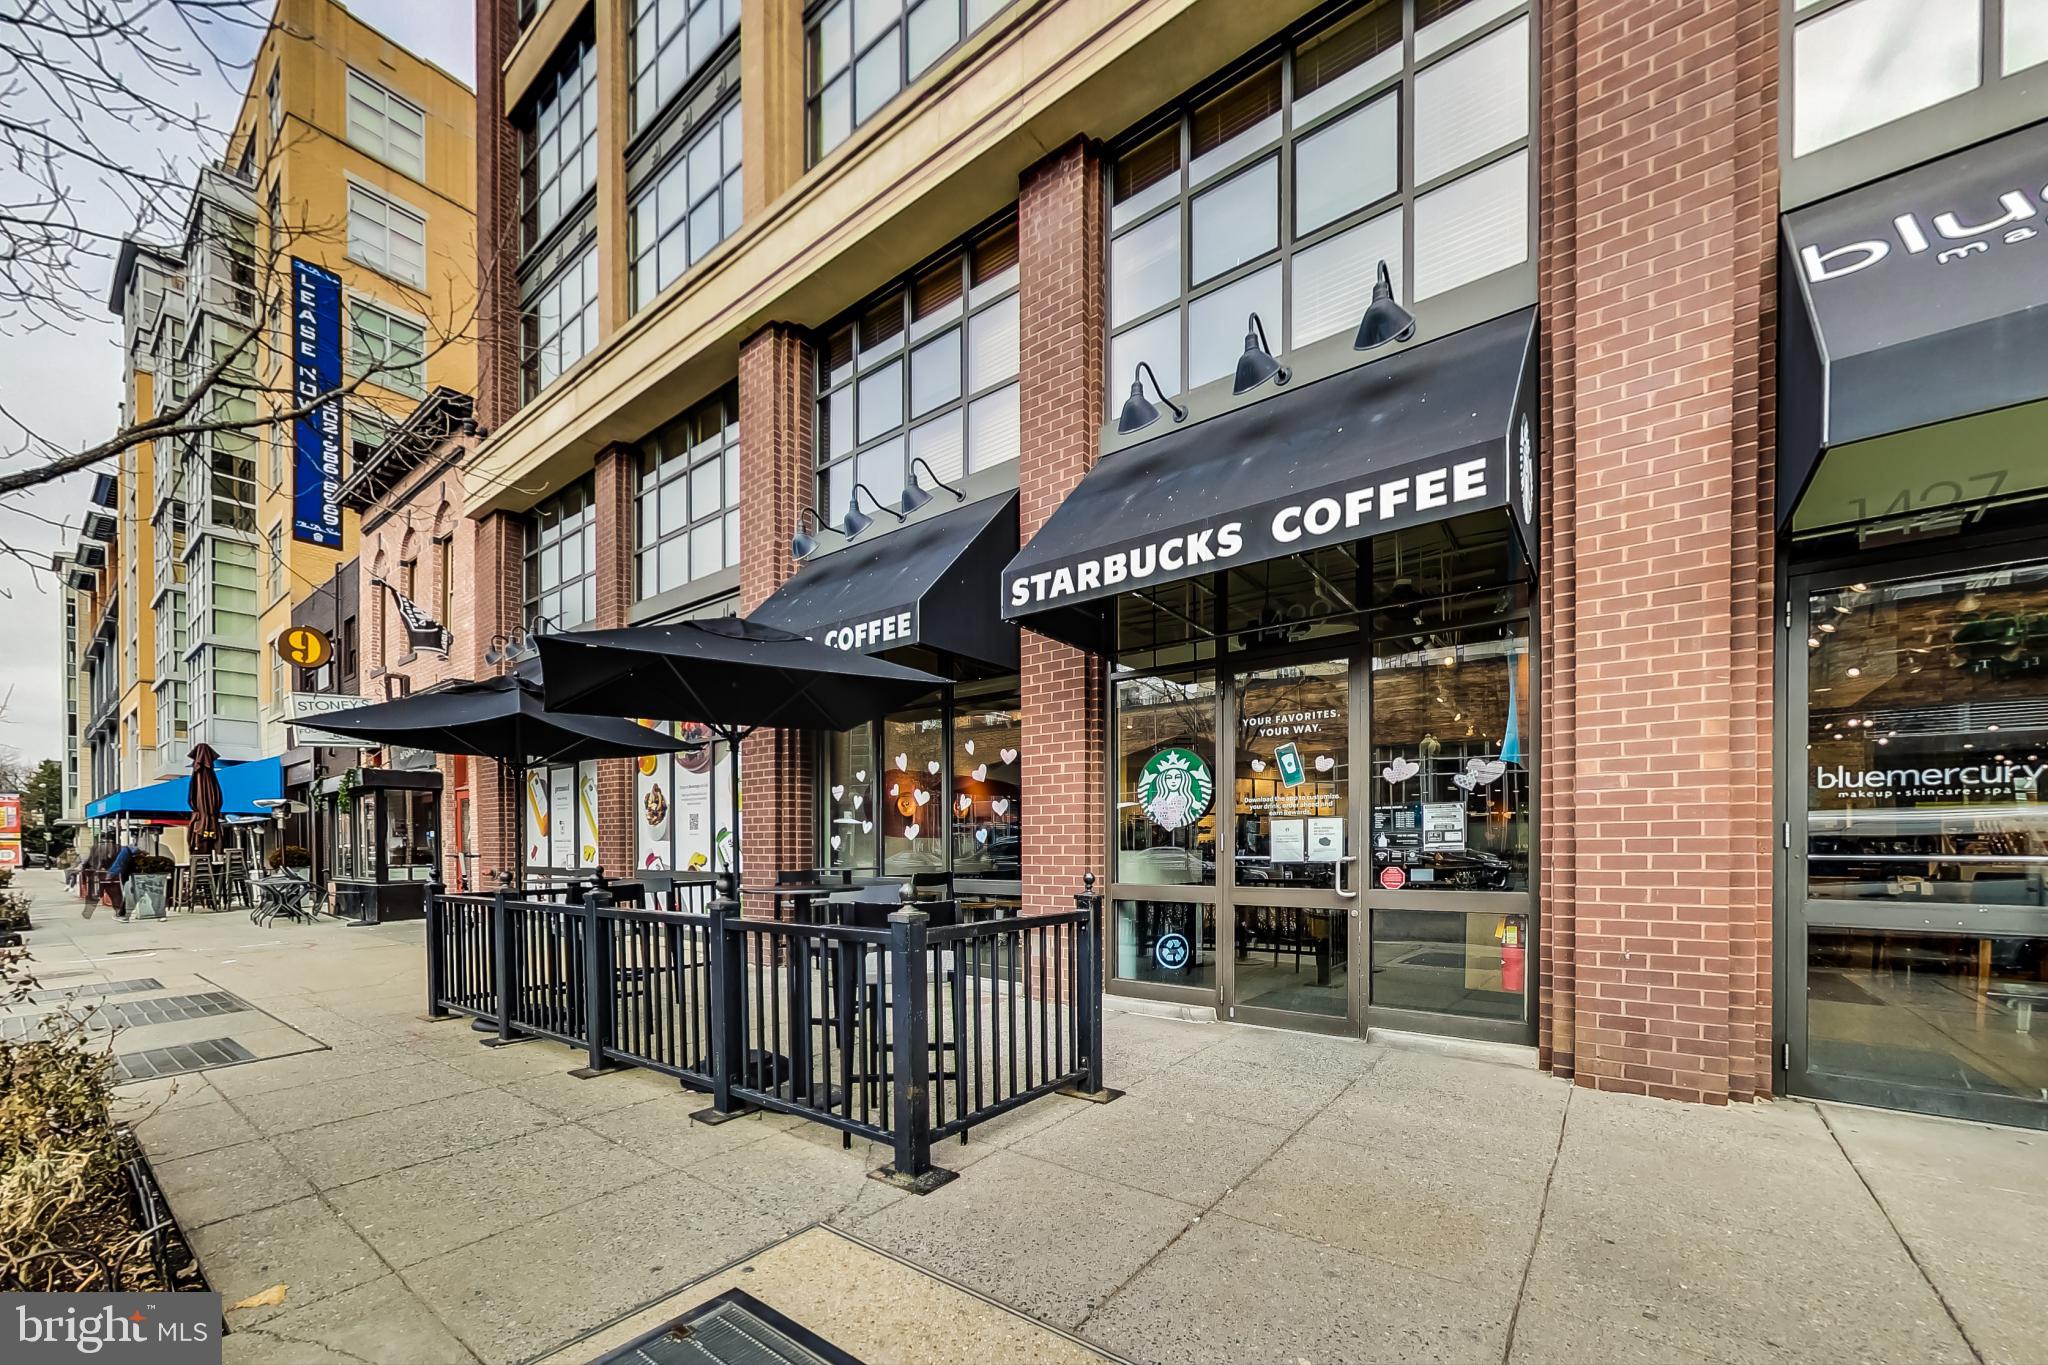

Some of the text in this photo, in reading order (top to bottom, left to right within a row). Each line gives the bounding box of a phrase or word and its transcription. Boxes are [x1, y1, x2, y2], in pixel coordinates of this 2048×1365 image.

[298, 273, 317, 358] LEASE
[1849, 470, 2008, 543] 1427
[1011, 458, 1487, 606] STARBUCKS COFFEE
[824, 612, 911, 651] COFFEE
[288, 630, 321, 664] 9
[1243, 709, 1341, 727] YOUR FAVORITES.
[1260, 723, 1322, 737] YOUR WAY.
[1817, 764, 2047, 789] bluemercury
[1244, 796, 1274, 804] Download
[1838, 787, 2012, 799] makeup skincare spa
[1249, 803, 1263, 811] your
